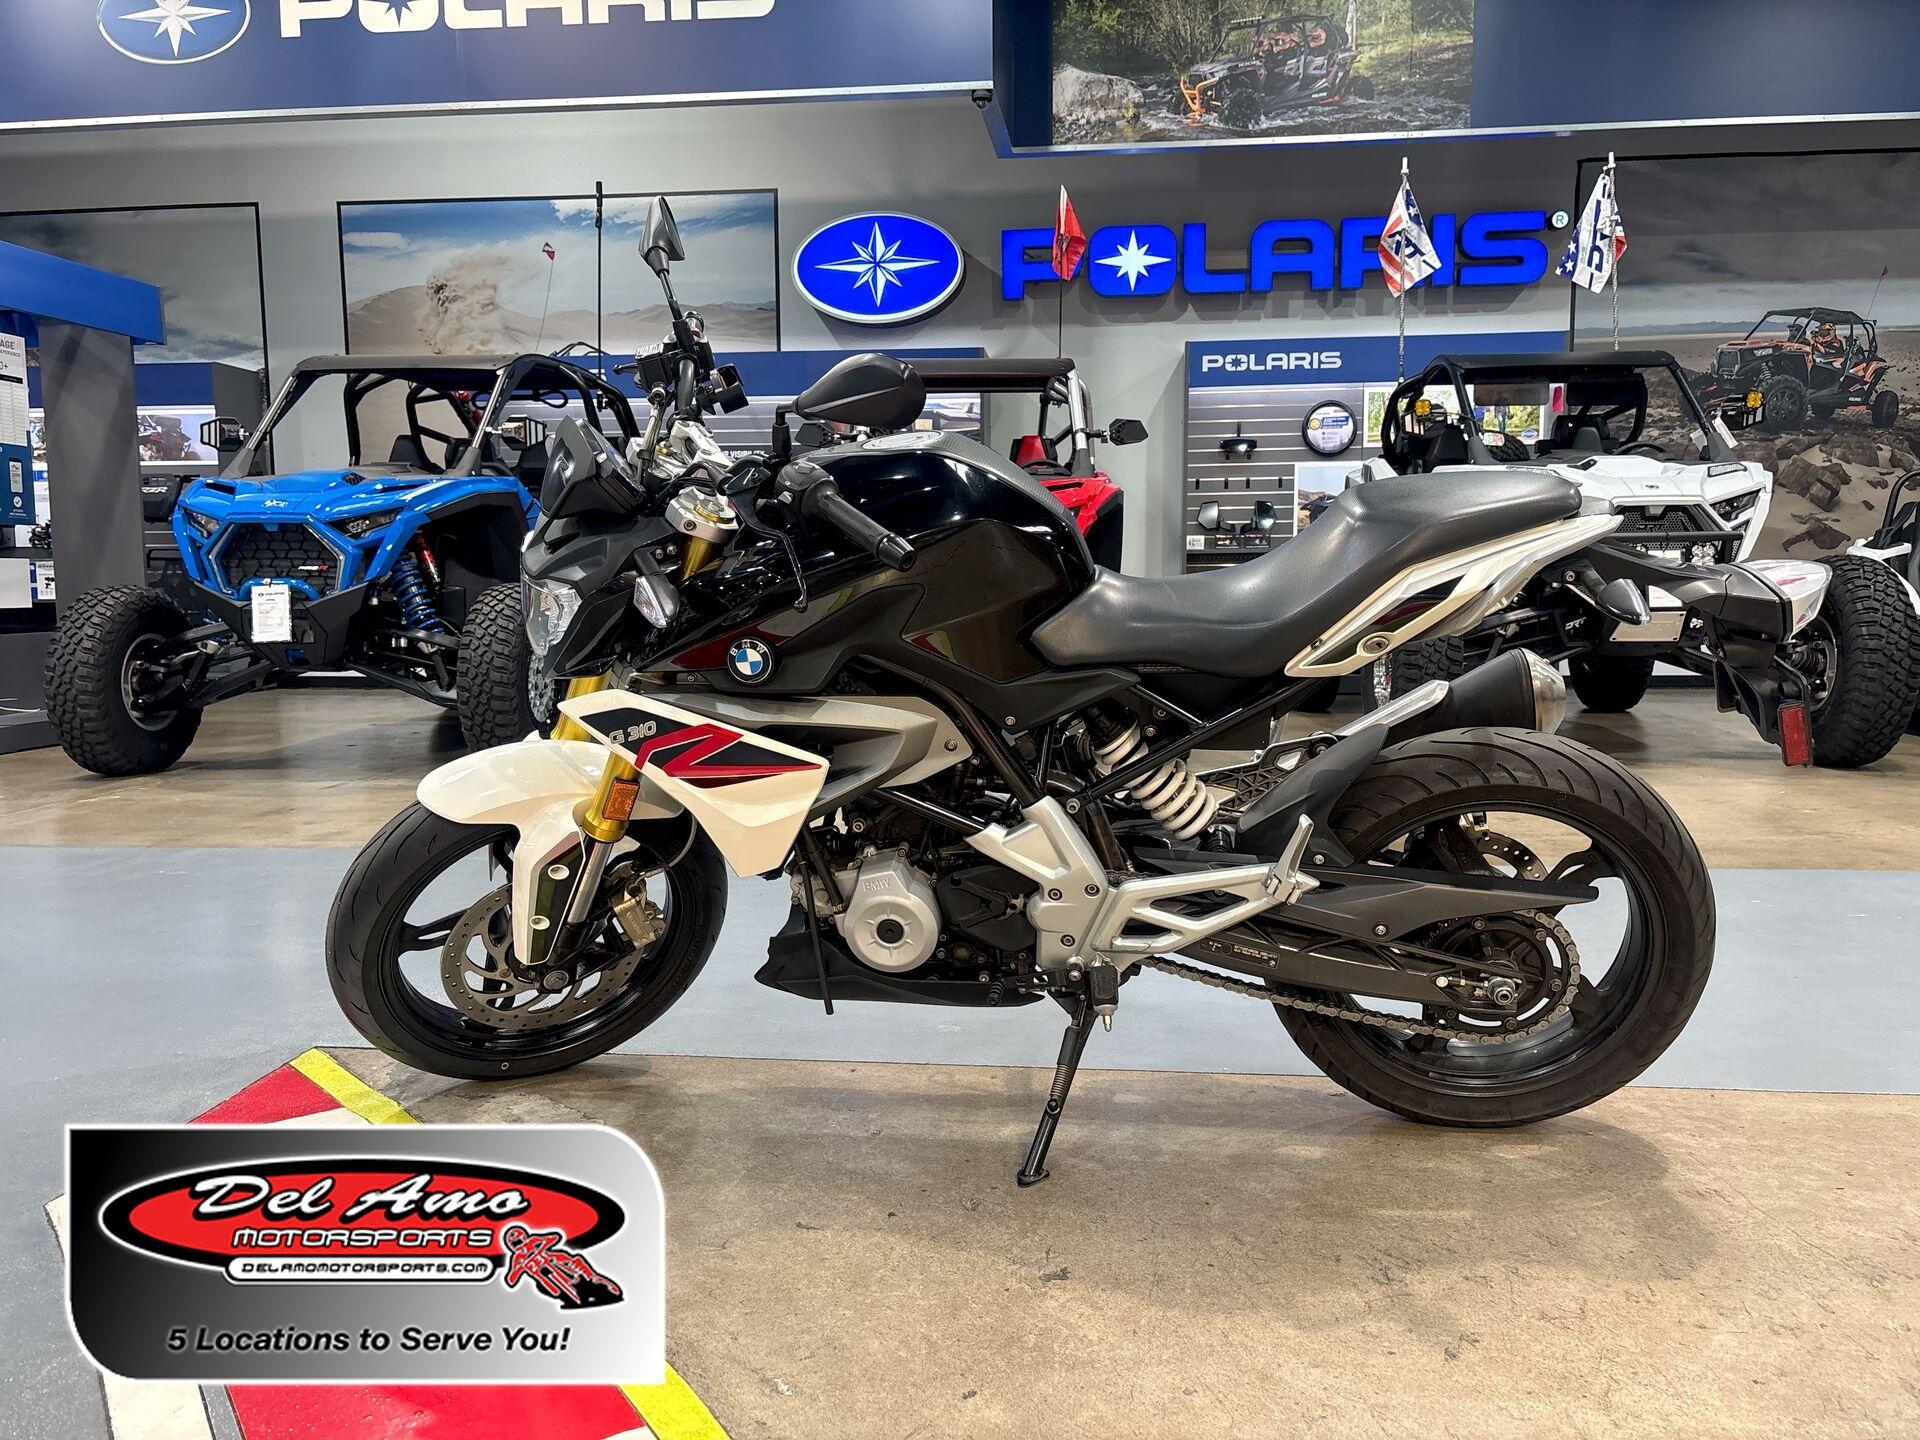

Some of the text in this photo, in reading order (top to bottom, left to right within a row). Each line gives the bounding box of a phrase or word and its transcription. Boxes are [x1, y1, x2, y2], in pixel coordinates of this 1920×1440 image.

[1202, 351, 1342, 373] POLARIS
[730, 640, 766, 657] BMW
[609, 729, 625, 744] G
[627, 720, 657, 742] 310
